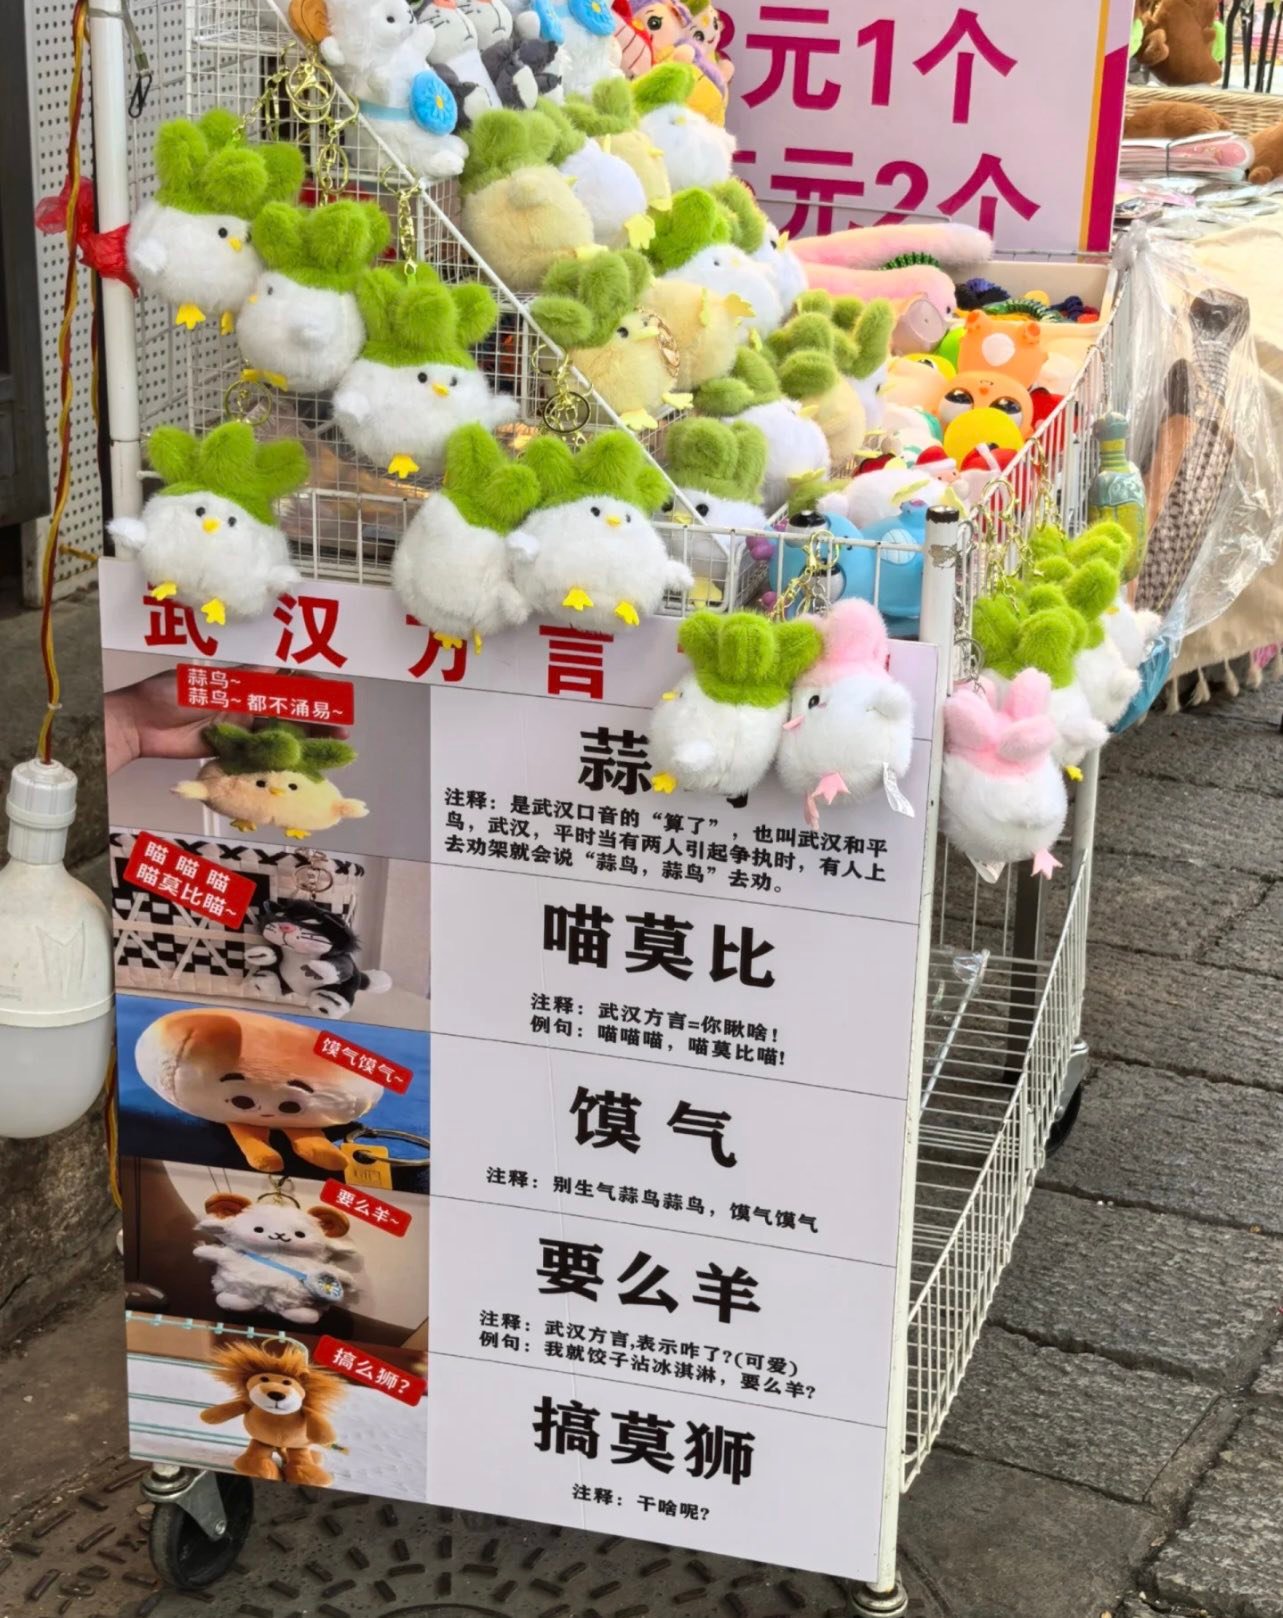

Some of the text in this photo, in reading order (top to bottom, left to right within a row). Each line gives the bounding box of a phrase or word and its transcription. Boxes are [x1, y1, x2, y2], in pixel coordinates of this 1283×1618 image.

[732, 147, 1041, 240] 元2个
[187, 668, 241, 689] 蒜鸟~
[444, 787, 888, 858] 注释：是武汉口音的“算了”，也叫武汉和平
[445, 811, 887, 883] 鸟，武汉，平时当有两人引起争执时，有人上
[444, 834, 783, 894] 去劝架就会说“蒜鸟，蒜鸟”去劝。
[542, 903, 776, 988] 喵莫比
[530, 992, 778, 1042] 注释：武汉方言=你瞅啥！
[321, 1037, 403, 1083] 馍气馍气~
[569, 1086, 738, 1168] 馍气
[336, 1188, 400, 1225] 要么羊~
[486, 1167, 819, 1233] 注释：别生气蒜鸟蒜鸟，馍气馍气
[536, 1237, 761, 1324] 要么羊
[332, 1347, 411, 1394] 搞么狮?
[532, 1396, 755, 1486] 搞莫狮
[572, 1483, 710, 1520] 注释：干啥呢?
